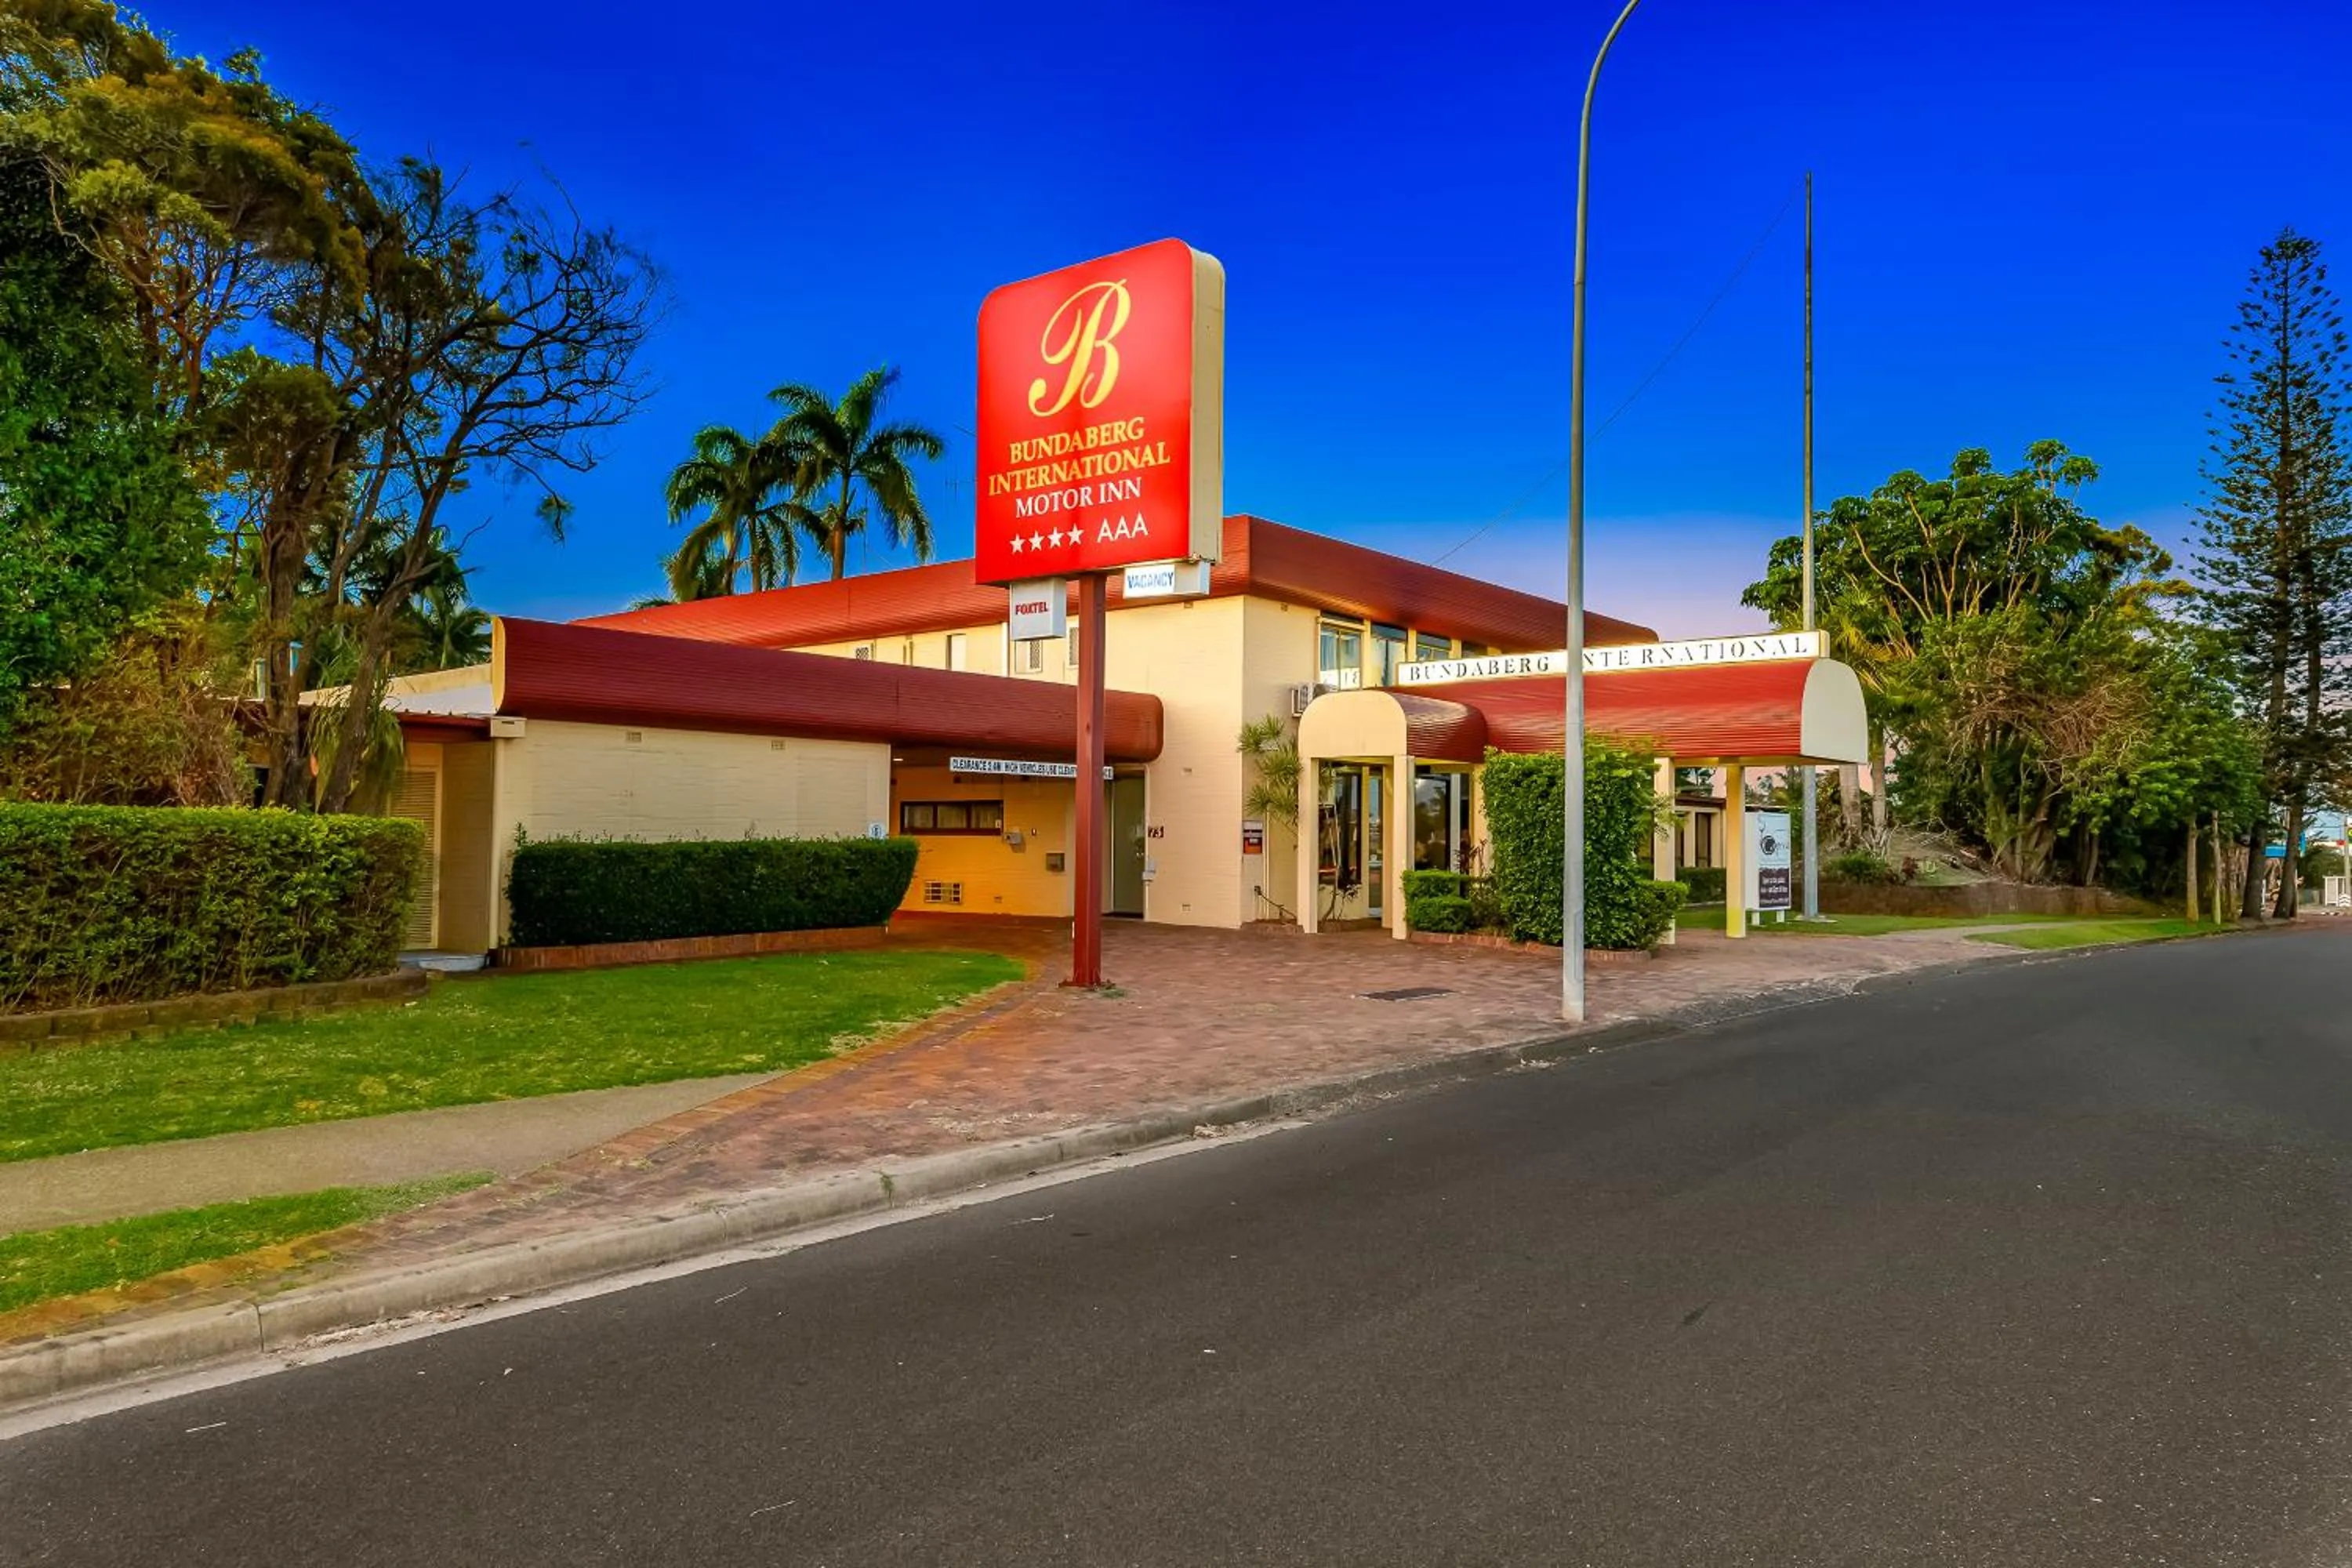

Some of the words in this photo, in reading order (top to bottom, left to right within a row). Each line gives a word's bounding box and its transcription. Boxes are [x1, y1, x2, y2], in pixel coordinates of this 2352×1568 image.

[1028, 278, 1131, 417] B
[1010, 416, 1145, 464] BUNDABERG
[989, 441, 1171, 496] INTERNATIONAL
[1015, 485, 1093, 518] MOTOR
[1099, 477, 1142, 504] INN
[1097, 511, 1149, 543] AAA
[1127, 572, 1174, 590] VACANCY
[1015, 601, 1049, 615] FOXTEL
[1410, 656, 1550, 681] BUNDABERG
[1582, 637, 1807, 667] NTERNATIONAL
[953, 758, 986, 771] CLEARANCE
